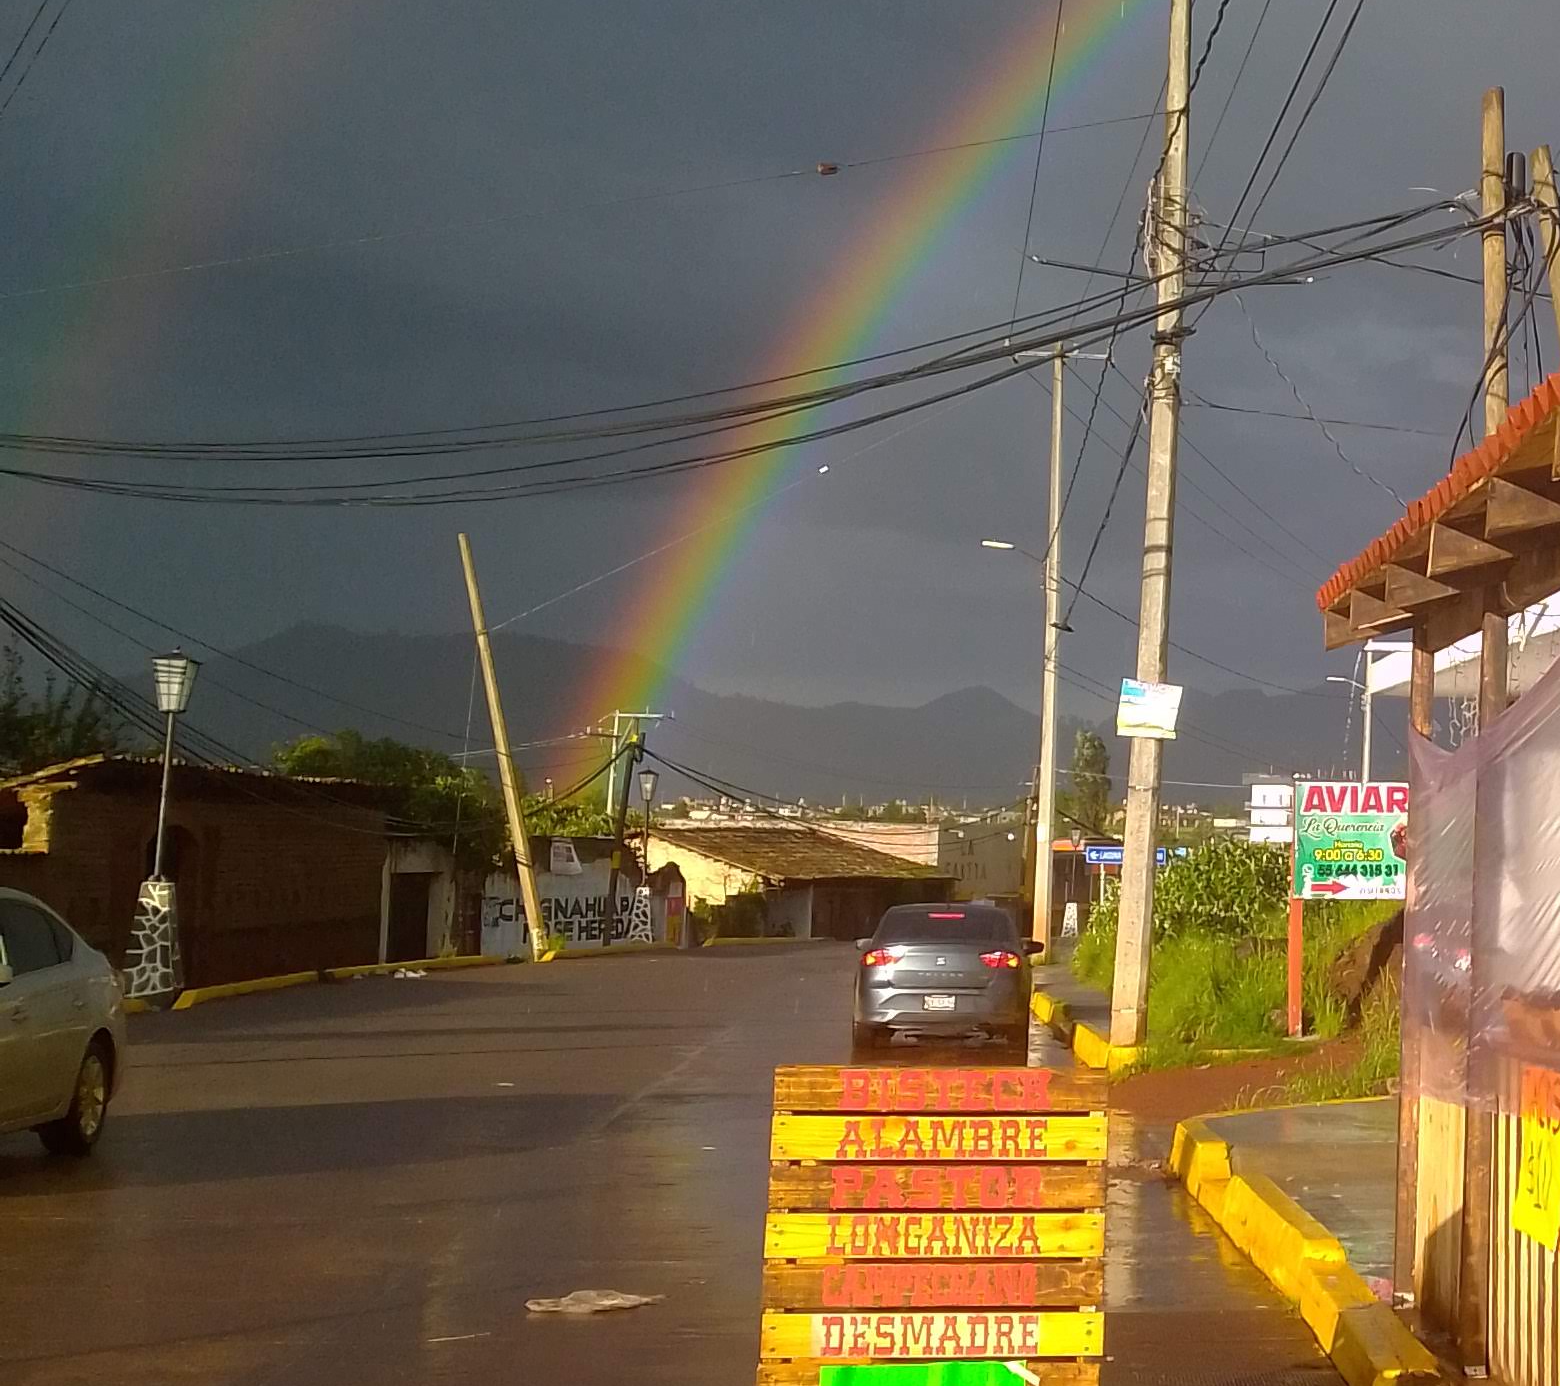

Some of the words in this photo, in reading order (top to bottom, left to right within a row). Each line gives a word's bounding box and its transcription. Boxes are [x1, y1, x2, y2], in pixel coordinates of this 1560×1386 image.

[1303, 786, 1408, 813] AVIAR
[1314, 849, 1341, 861] 9:00
[1356, 849, 1383, 861] 6:30
[836, 1119, 1048, 1158] ALAMBRE
[830, 1167, 1041, 1210] PASTOR
[826, 1215, 1041, 1256] LONGANIZA
[821, 1316, 1039, 1356] DESMADRE
